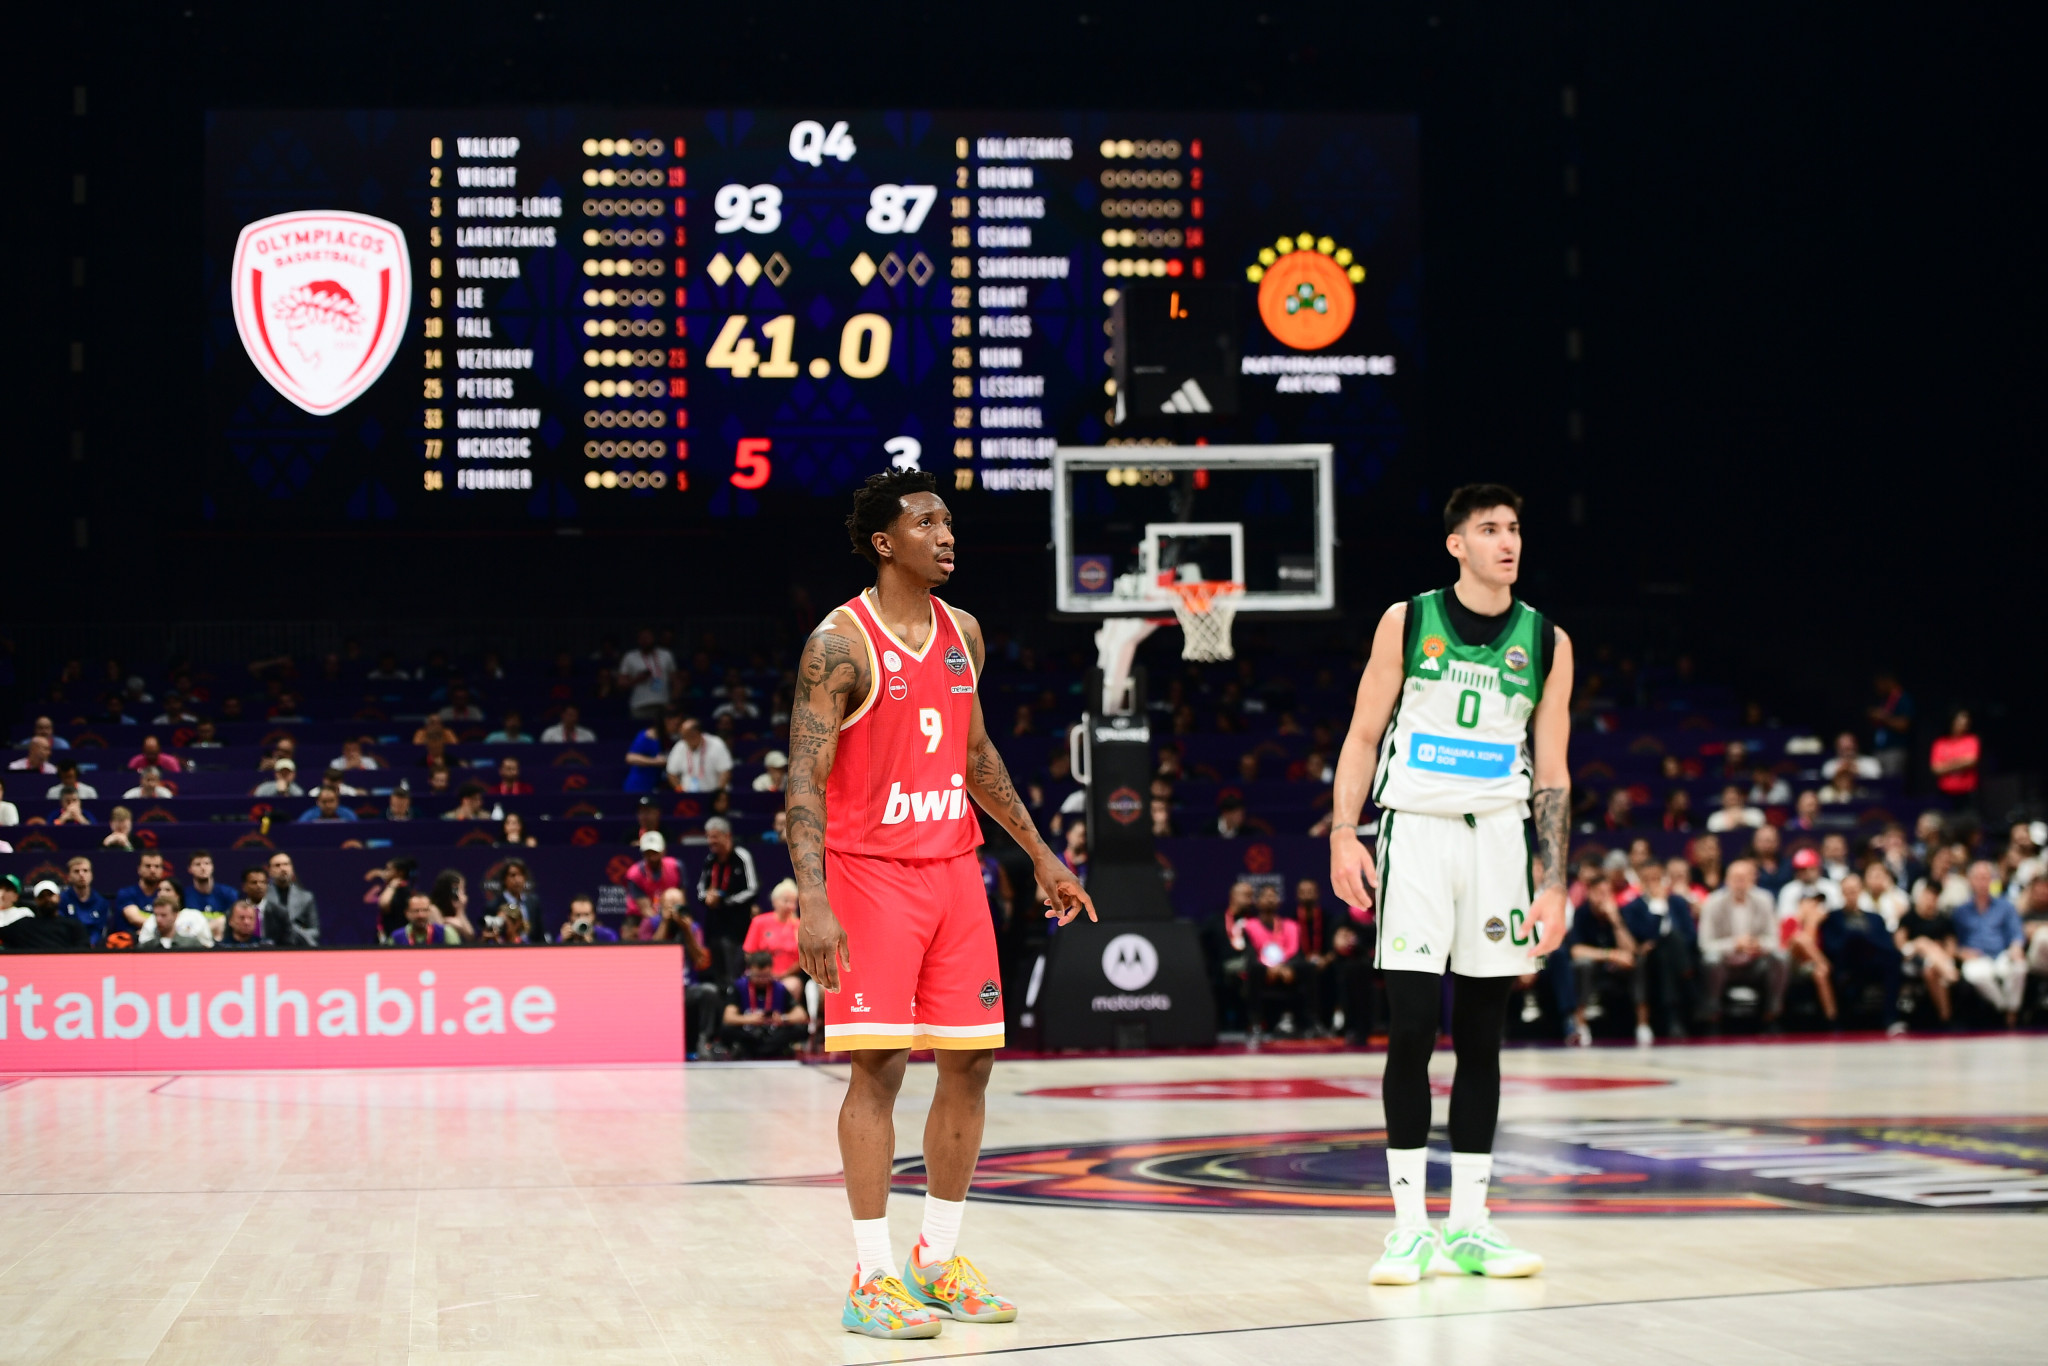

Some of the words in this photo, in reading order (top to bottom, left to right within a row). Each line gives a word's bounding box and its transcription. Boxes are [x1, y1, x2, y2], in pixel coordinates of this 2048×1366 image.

[456, 136, 520, 158] WALKUP
[788, 120, 857, 168] Q4
[430, 166, 442, 188] 2
[456, 166, 517, 188] WRIGHT
[430, 196, 442, 218] 3
[714, 183, 783, 234] 93
[865, 183, 938, 235] 87
[255, 229, 386, 256] OLYMPIACOS
[430, 226, 442, 247] 5
[456, 287, 484, 309] LEE
[456, 316, 492, 338] FALL
[978, 314, 1032, 338] PLEISS
[705, 313, 892, 379] 41.0
[456, 348, 534, 370] VEZENKOV
[423, 378, 443, 399] 25
[457, 377, 514, 399] PETERS
[425, 439, 443, 459] 77
[729, 437, 772, 490] 5
[457, 468, 533, 490] FOURNIER
[1457, 689, 1481, 729] 0
[919, 707, 943, 753] 9
[0, 970, 556, 1040] itabudhabi.ae
[1092, 992, 1171, 1012] motorola
